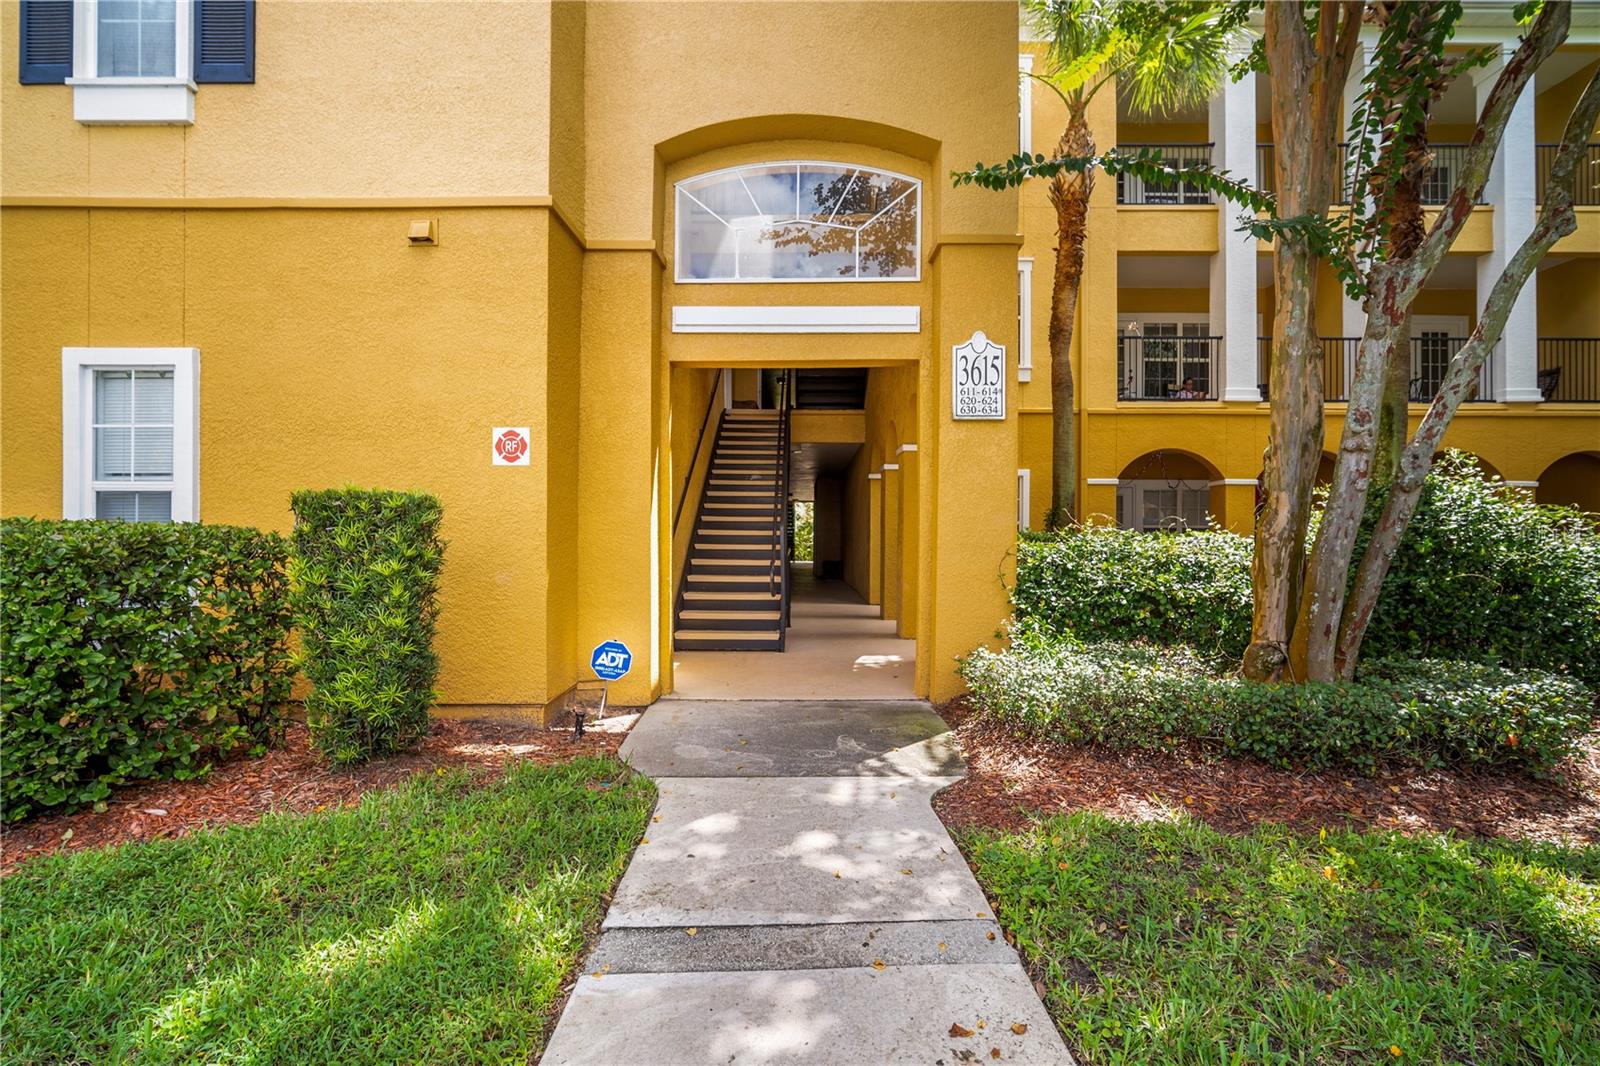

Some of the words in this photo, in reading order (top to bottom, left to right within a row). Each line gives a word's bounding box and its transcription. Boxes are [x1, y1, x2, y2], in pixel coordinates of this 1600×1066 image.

[959, 354, 1000, 386] 3615
[960, 387, 998, 396] 611-614
[960, 396, 998, 405] 620-624
[960, 405, 998, 414] 630-634
[505, 440, 518, 452] RF
[594, 651, 629, 668] ADT
